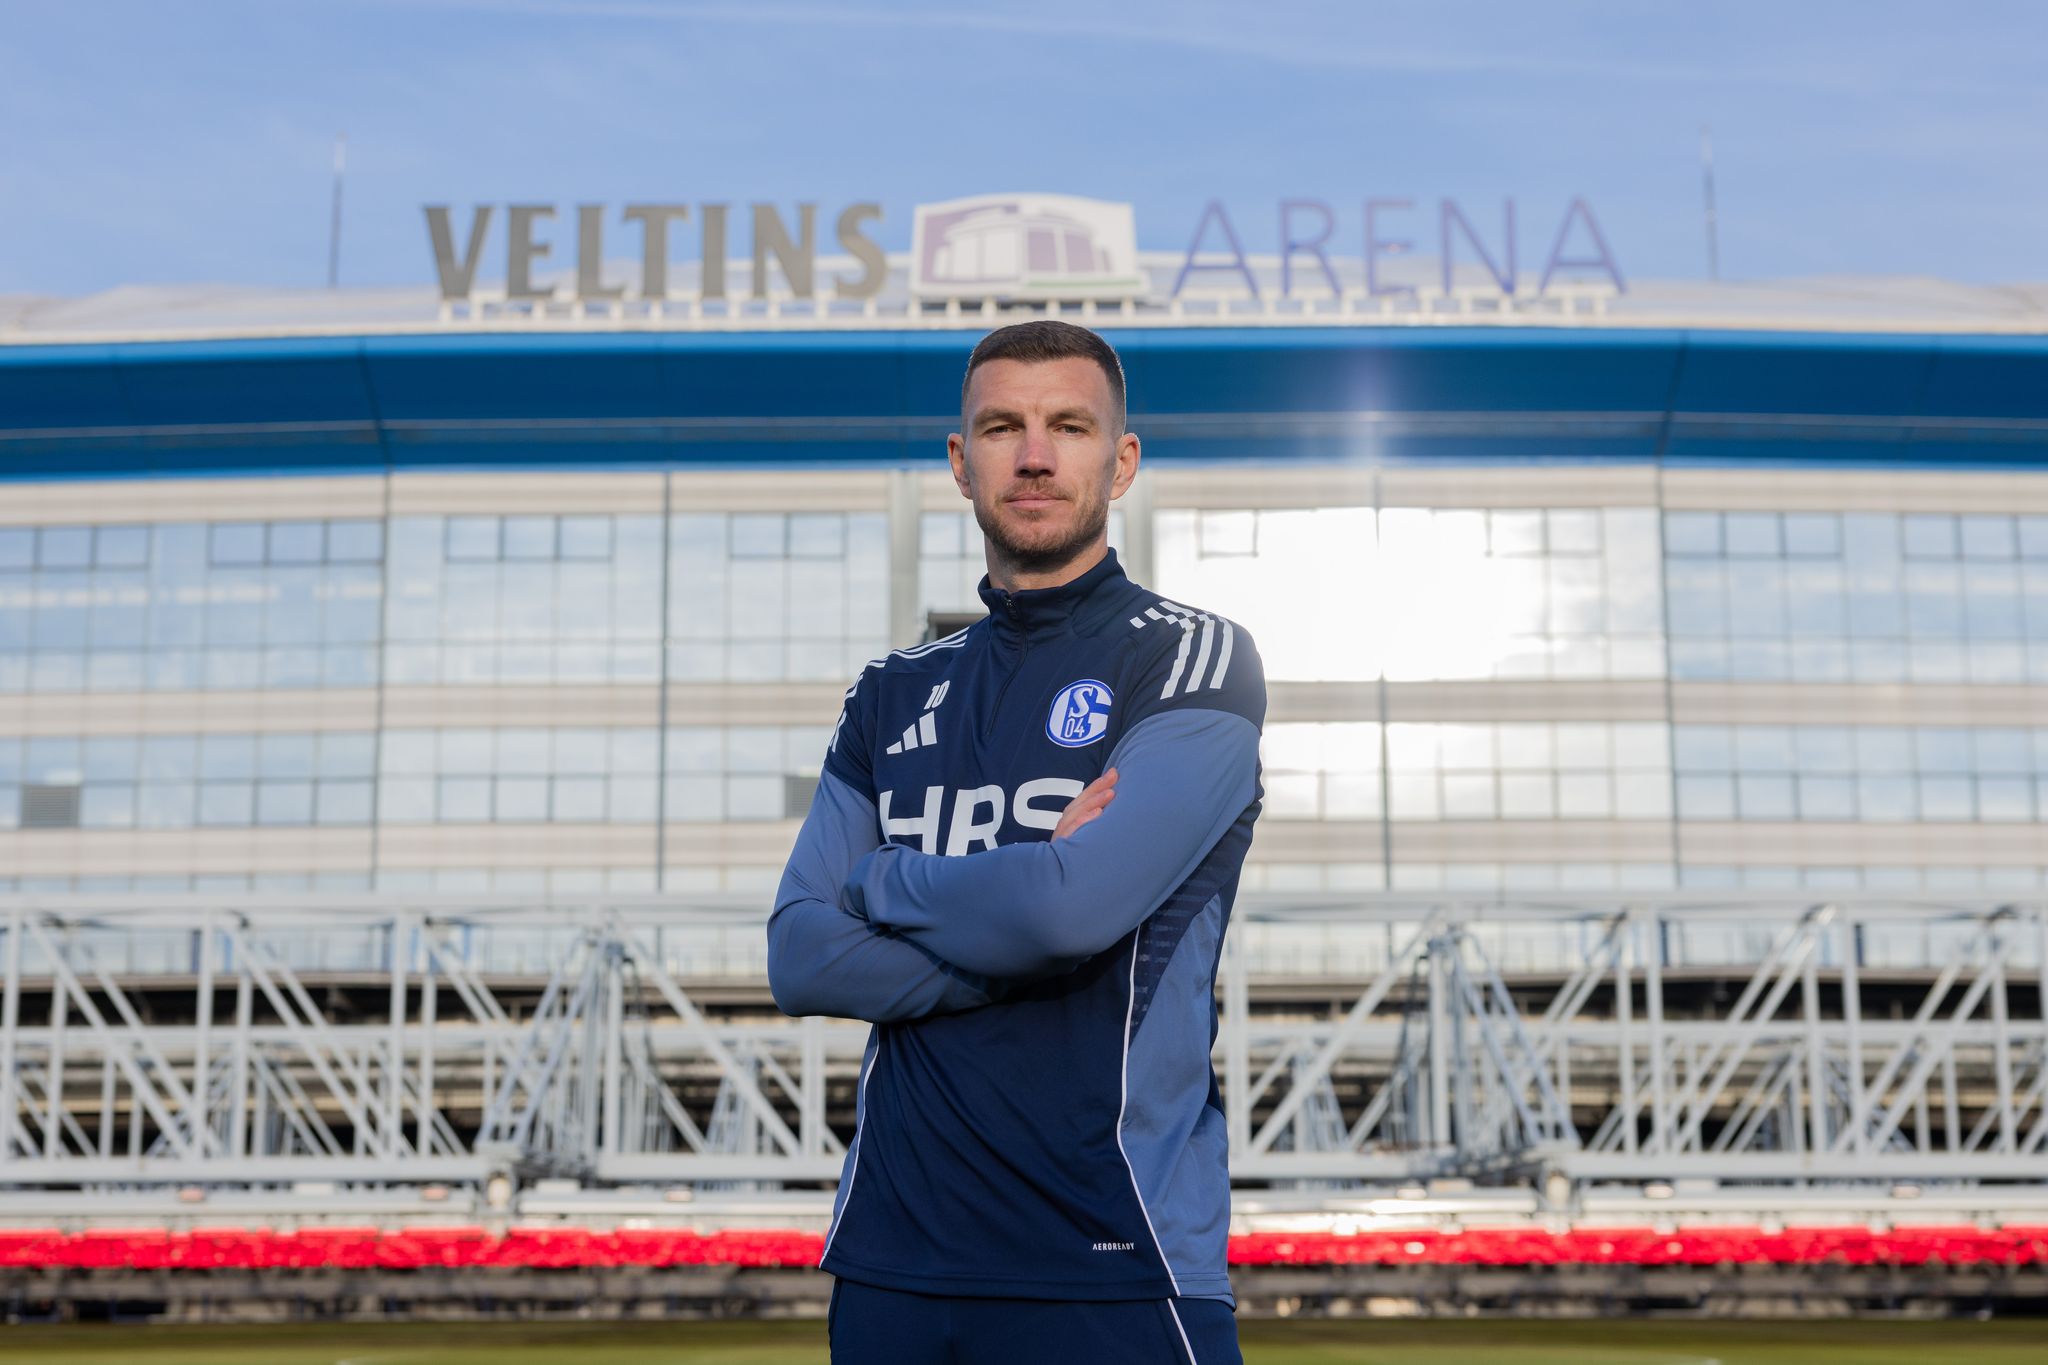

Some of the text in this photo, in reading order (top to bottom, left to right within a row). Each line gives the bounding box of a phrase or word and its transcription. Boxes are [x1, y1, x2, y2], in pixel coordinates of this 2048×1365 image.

[423, 197, 1627, 300] VELTINS ARENA
[924, 680, 950, 710] 10
[1068, 687, 1094, 718] S
[1064, 718, 1085, 738] 04
[879, 777, 1085, 857] HRS
[1092, 1242, 1135, 1251] AEROREADY
